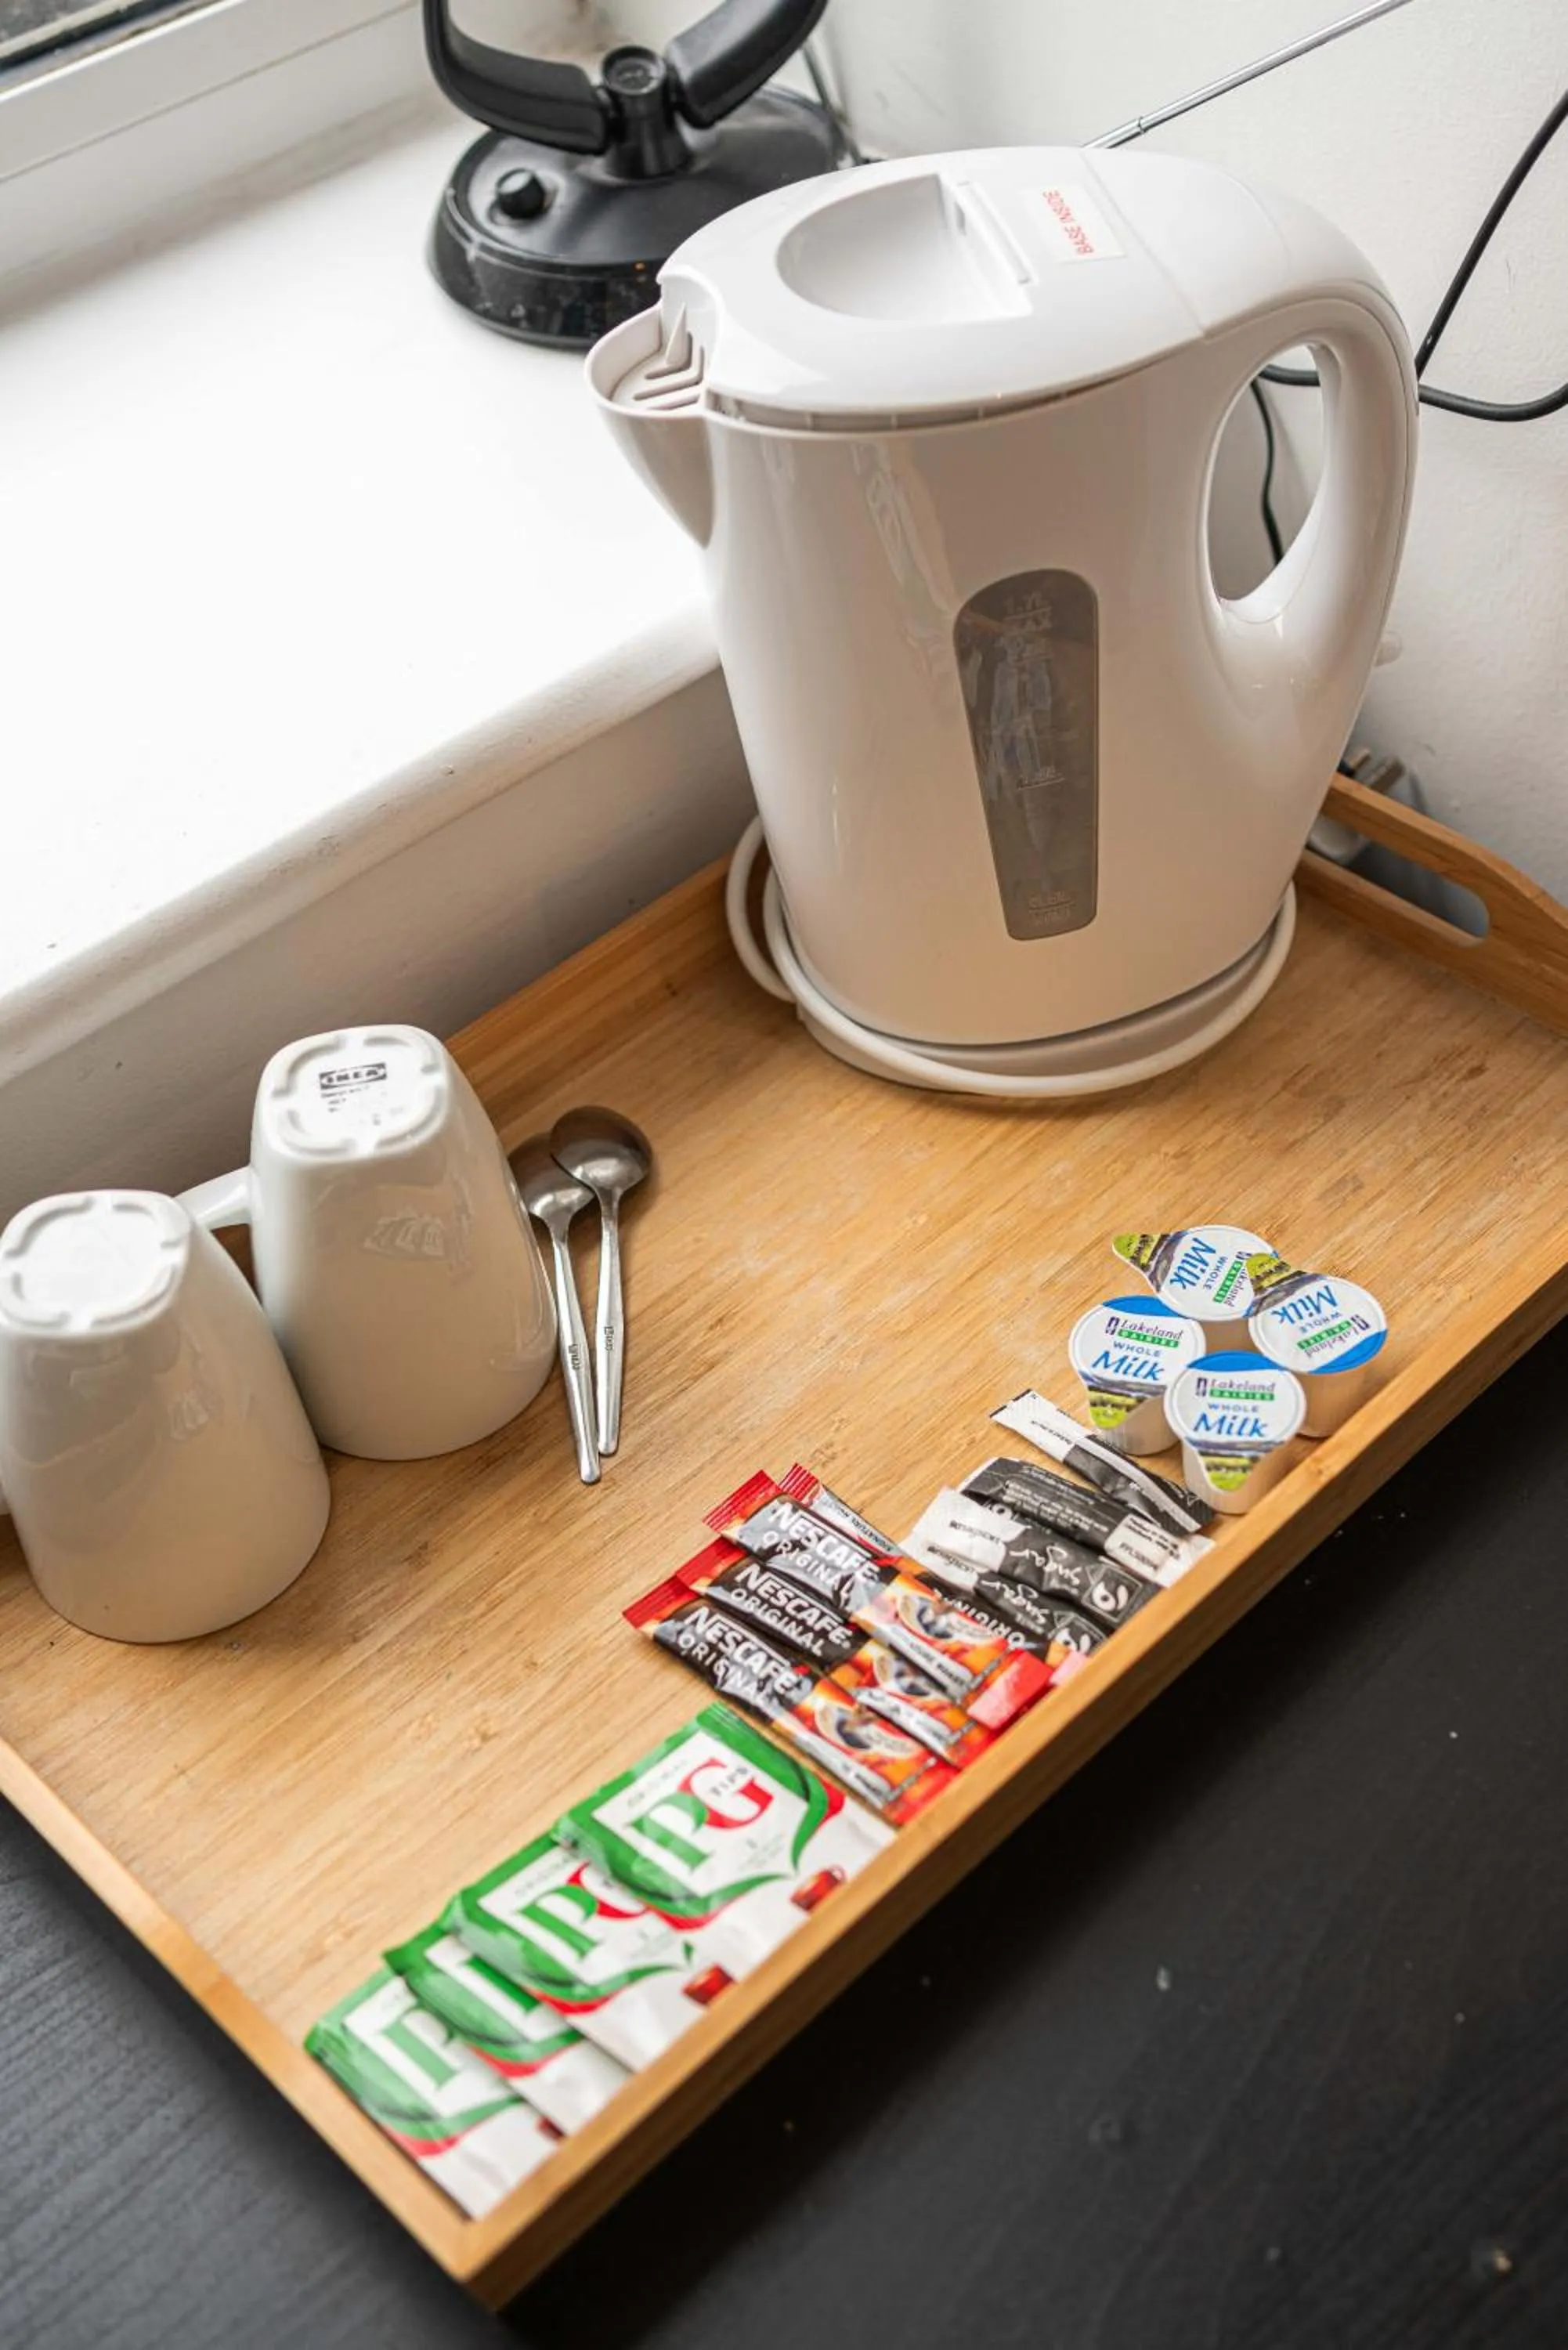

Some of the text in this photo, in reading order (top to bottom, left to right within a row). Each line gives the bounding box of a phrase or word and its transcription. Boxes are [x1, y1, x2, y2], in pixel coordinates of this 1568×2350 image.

[323, 1066, 382, 1086] IKEA
[1169, 1238, 1216, 1289] Milk
[1270, 1285, 1338, 1325] Milk
[1113, 1341, 1162, 1358] WHOLE
[1120, 1319, 1183, 1340] Lakeland
[1092, 1350, 1165, 1380] Milk
[1193, 1412, 1268, 1437] Milk
[1008, 1544, 1082, 1585] sugar
[934, 1587, 1025, 1650] ORIGIN
[981, 1580, 1050, 1624] sugar
[730, 1588, 825, 1657] ORIGINAL
